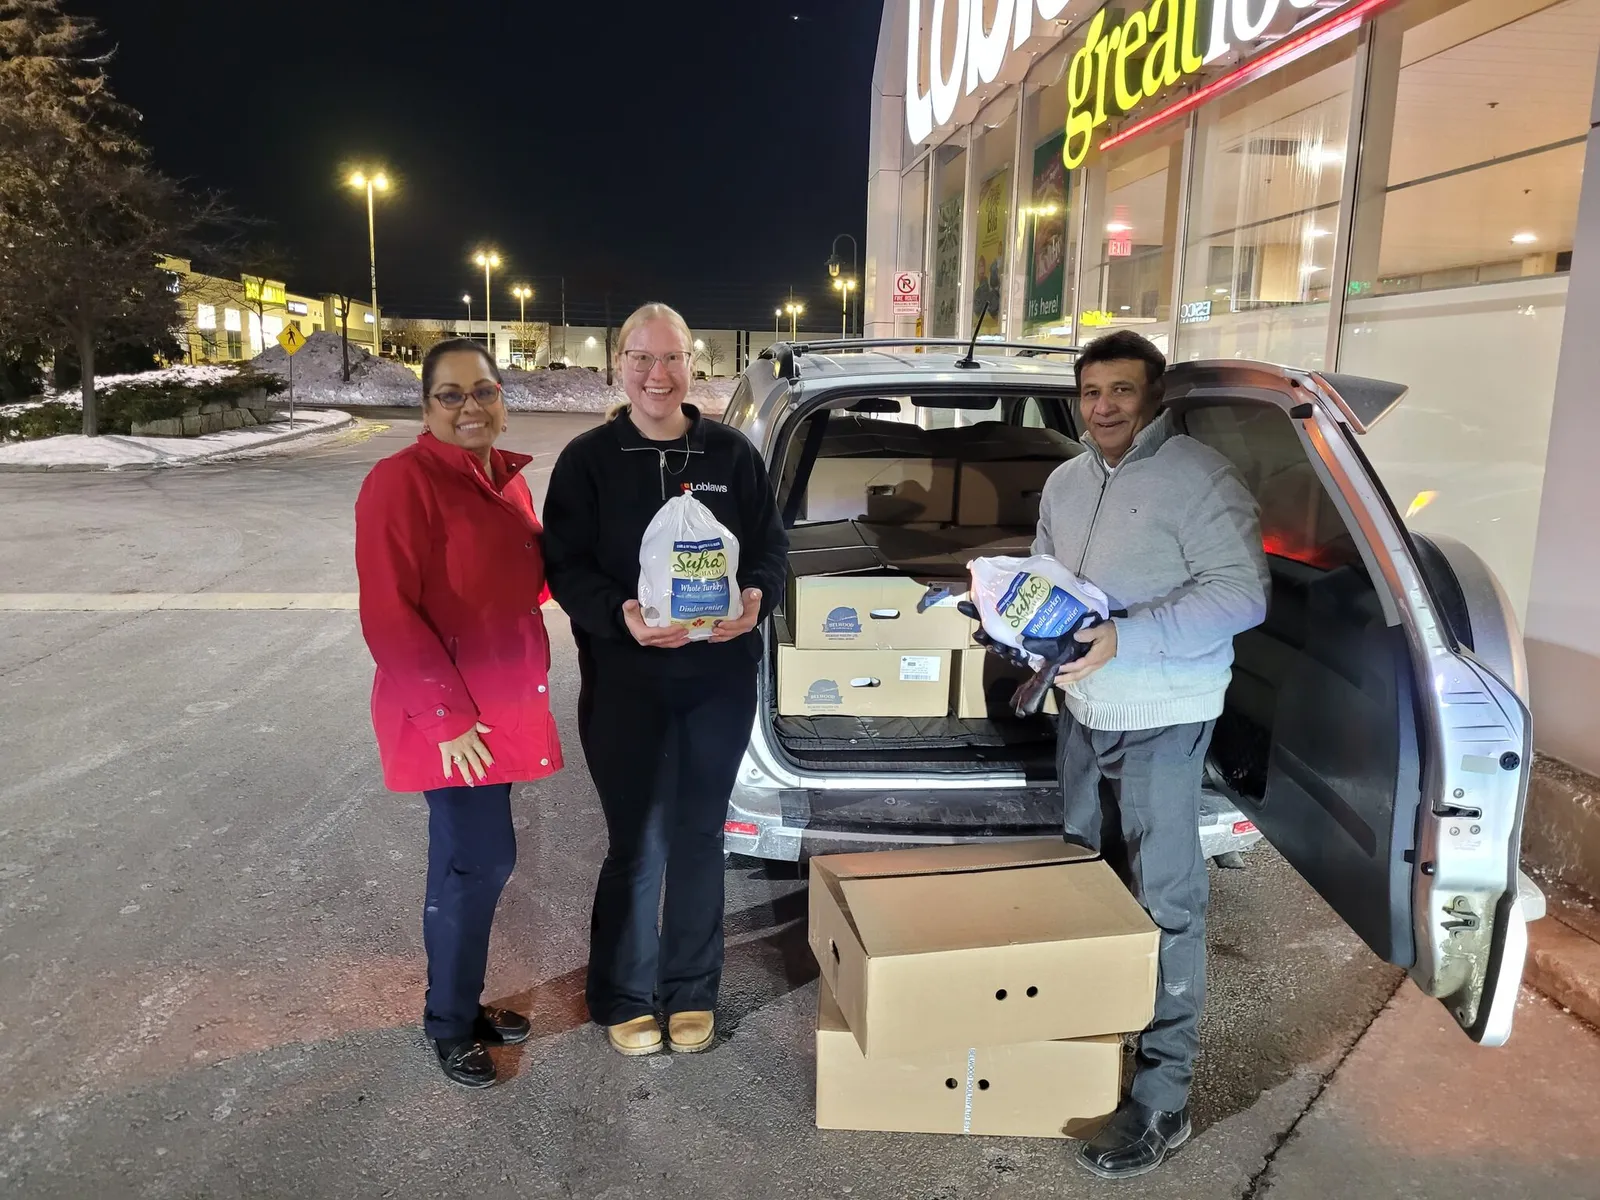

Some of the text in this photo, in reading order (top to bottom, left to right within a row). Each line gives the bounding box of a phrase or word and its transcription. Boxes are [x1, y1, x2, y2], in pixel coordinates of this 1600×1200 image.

[1111, 241, 1129, 256] EXIT
[1039, 295, 1059, 315] here!
[690, 482, 728, 493] Loblaws
[673, 549, 722, 572] Sufra
[680, 582, 723, 593] Whole Turkey
[679, 603, 723, 612] Dindon entier
[1005, 579, 1043, 628] Sufra
[1030, 612, 1046, 635] Whole
[1045, 594, 1062, 617] Turkey
[1064, 606, 1080, 627] entier
[968, 1050, 976, 1079] BELWOOD
[966, 1080, 974, 1107] POULTRY
